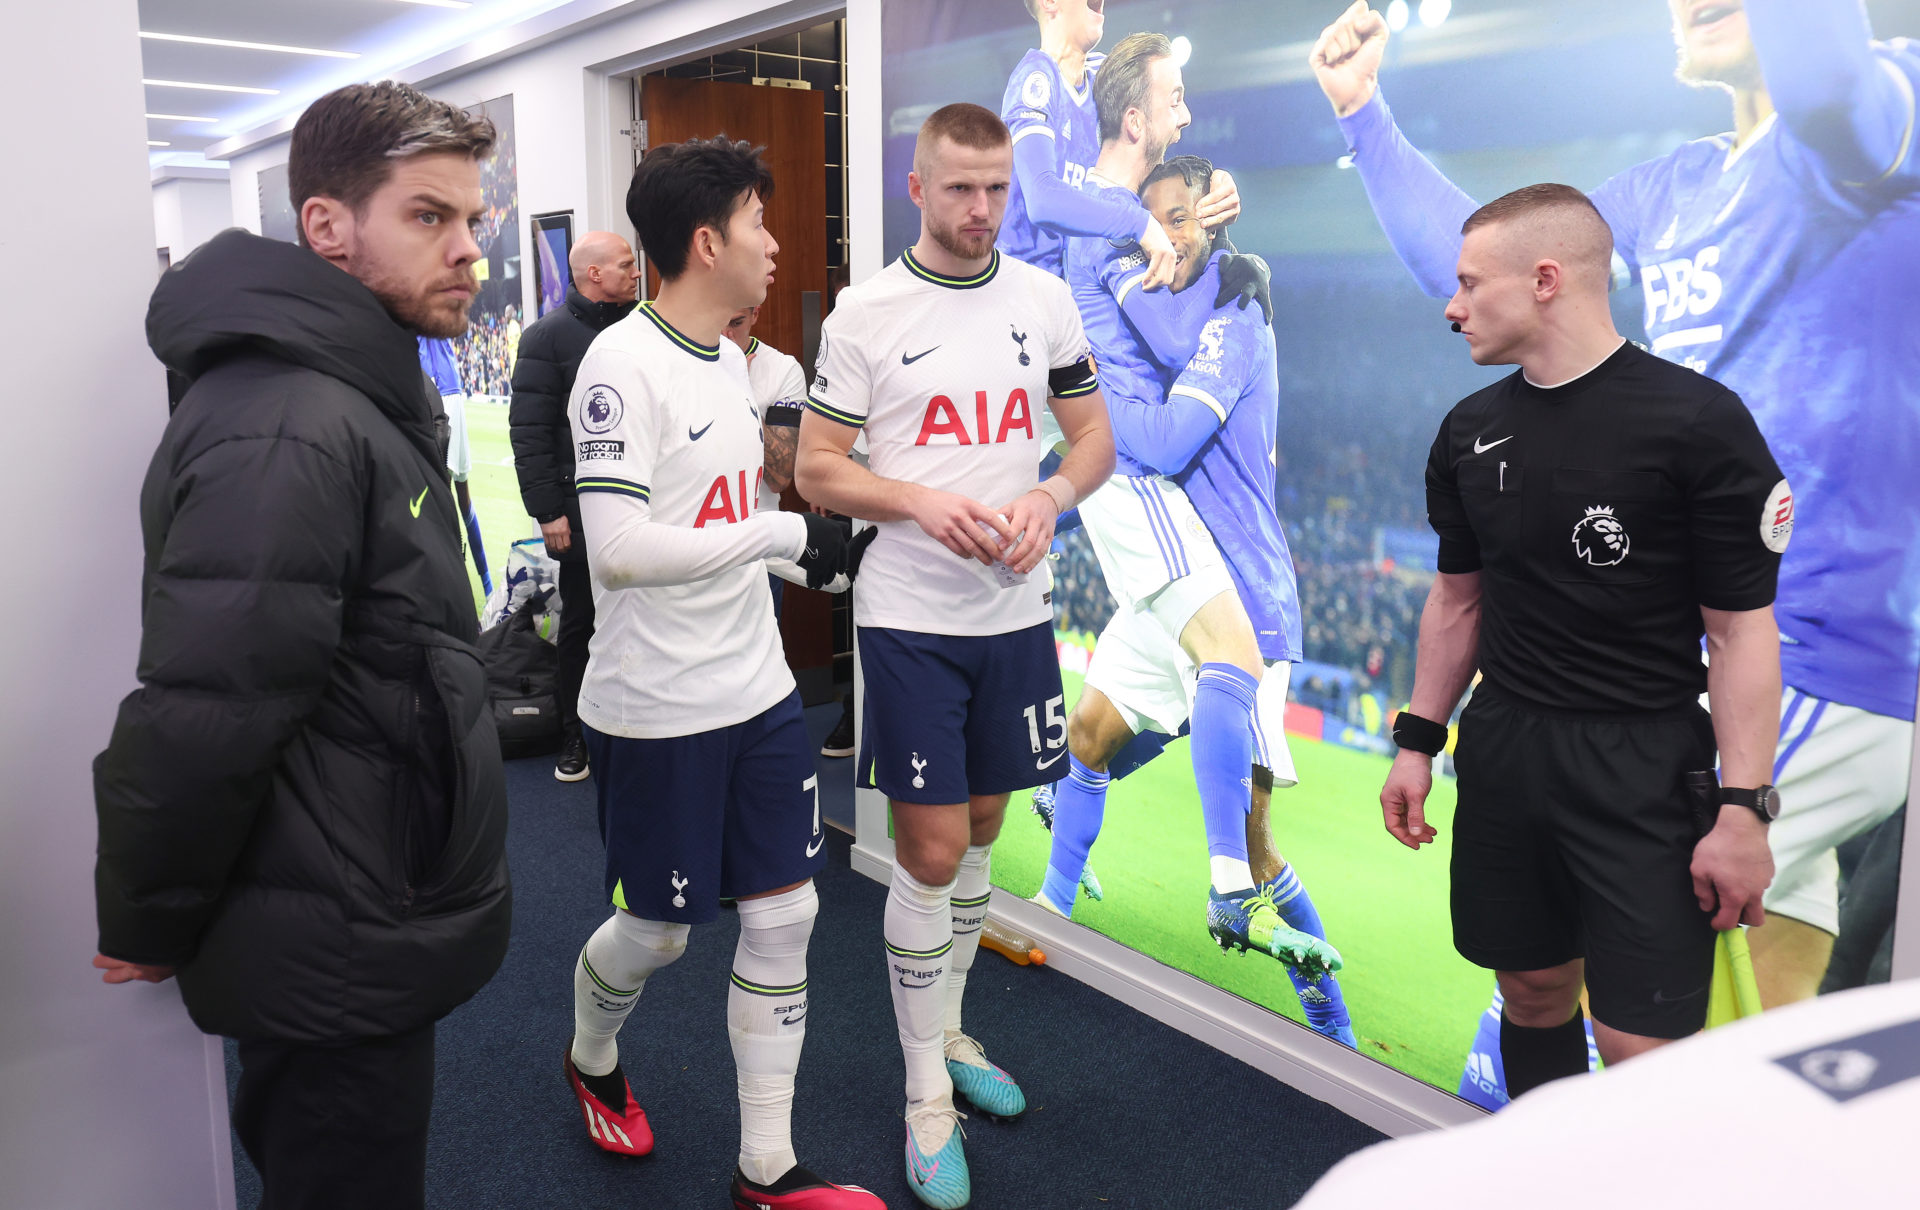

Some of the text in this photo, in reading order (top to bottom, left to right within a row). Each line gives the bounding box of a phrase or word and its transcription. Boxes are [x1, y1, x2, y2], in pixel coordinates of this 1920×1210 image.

[1641, 245, 1722, 331] FBS
[915, 387, 1033, 446] AIA
[578, 441, 620, 452] No room
[589, 450, 624, 461] racism
[1023, 694, 1068, 754] 15
[803, 772, 819, 836] 7
[893, 964, 943, 979] SPURS
[773, 1000, 808, 1015] SPU
